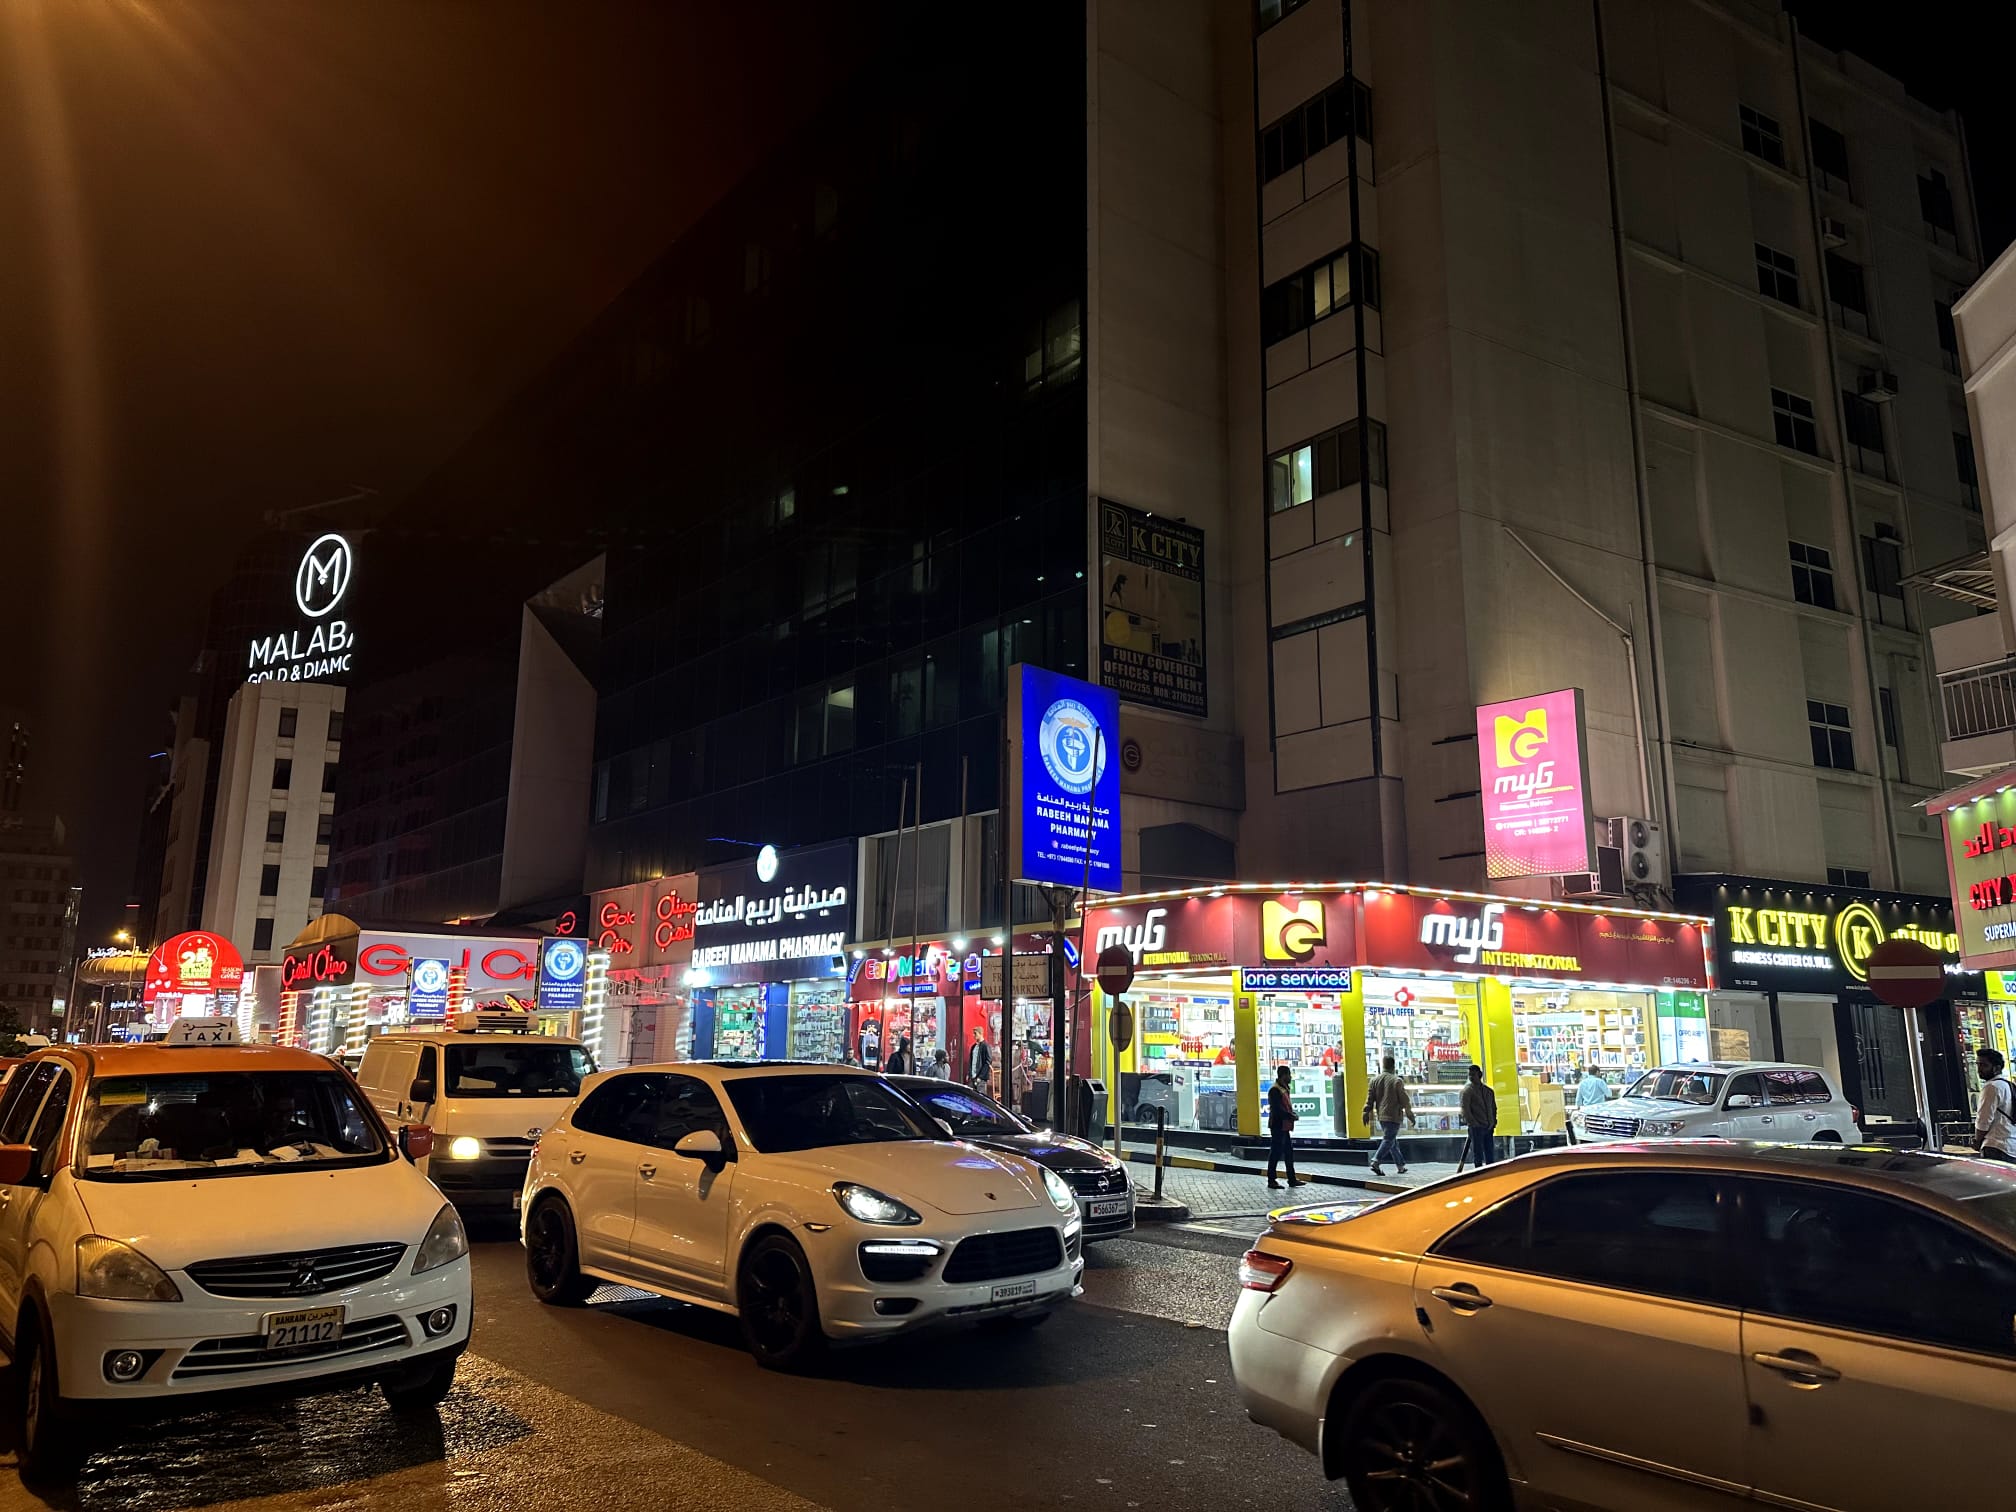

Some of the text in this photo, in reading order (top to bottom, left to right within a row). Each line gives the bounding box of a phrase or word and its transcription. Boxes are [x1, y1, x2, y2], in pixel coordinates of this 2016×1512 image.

[1131, 526, 1147, 551] K
[1151, 532, 1200, 567] CITY
[290, 664, 301, 682] &
[1104, 659, 1203, 693] OFFICES FOR RENT
[1113, 647, 1197, 678] FULLY COVERED
[1494, 760, 1555, 800] myG
[1037, 806, 1071, 822] RABEEH
[695, 884, 846, 926] صيدلية ربيع المنامة
[1969, 876, 2003, 912] CITY
[1096, 908, 1167, 964] myG
[1421, 903, 1506, 964] myG
[1728, 906, 1828, 950] K CITY
[1851, 925, 1873, 959] K
[692, 932, 845, 968] RABEEH MANAMA PHARMACY
[1482, 951, 1582, 972] INTERNATIONAL
[1732, 950, 1773, 965] BUSINESS
[1773, 952, 1802, 967] CENTER
[1369, 1007, 1415, 1016] SPECIAL OFFER
[183, 1031, 233, 1041] TAXI
[1181, 1041, 1203, 1053] OFFER
[1438, 1049, 1459, 1060] OFFER
[1292, 1102, 1315, 1112] oppo
[275, 1315, 307, 1324] BAHRAIN
[276, 1322, 333, 1347] 21112
